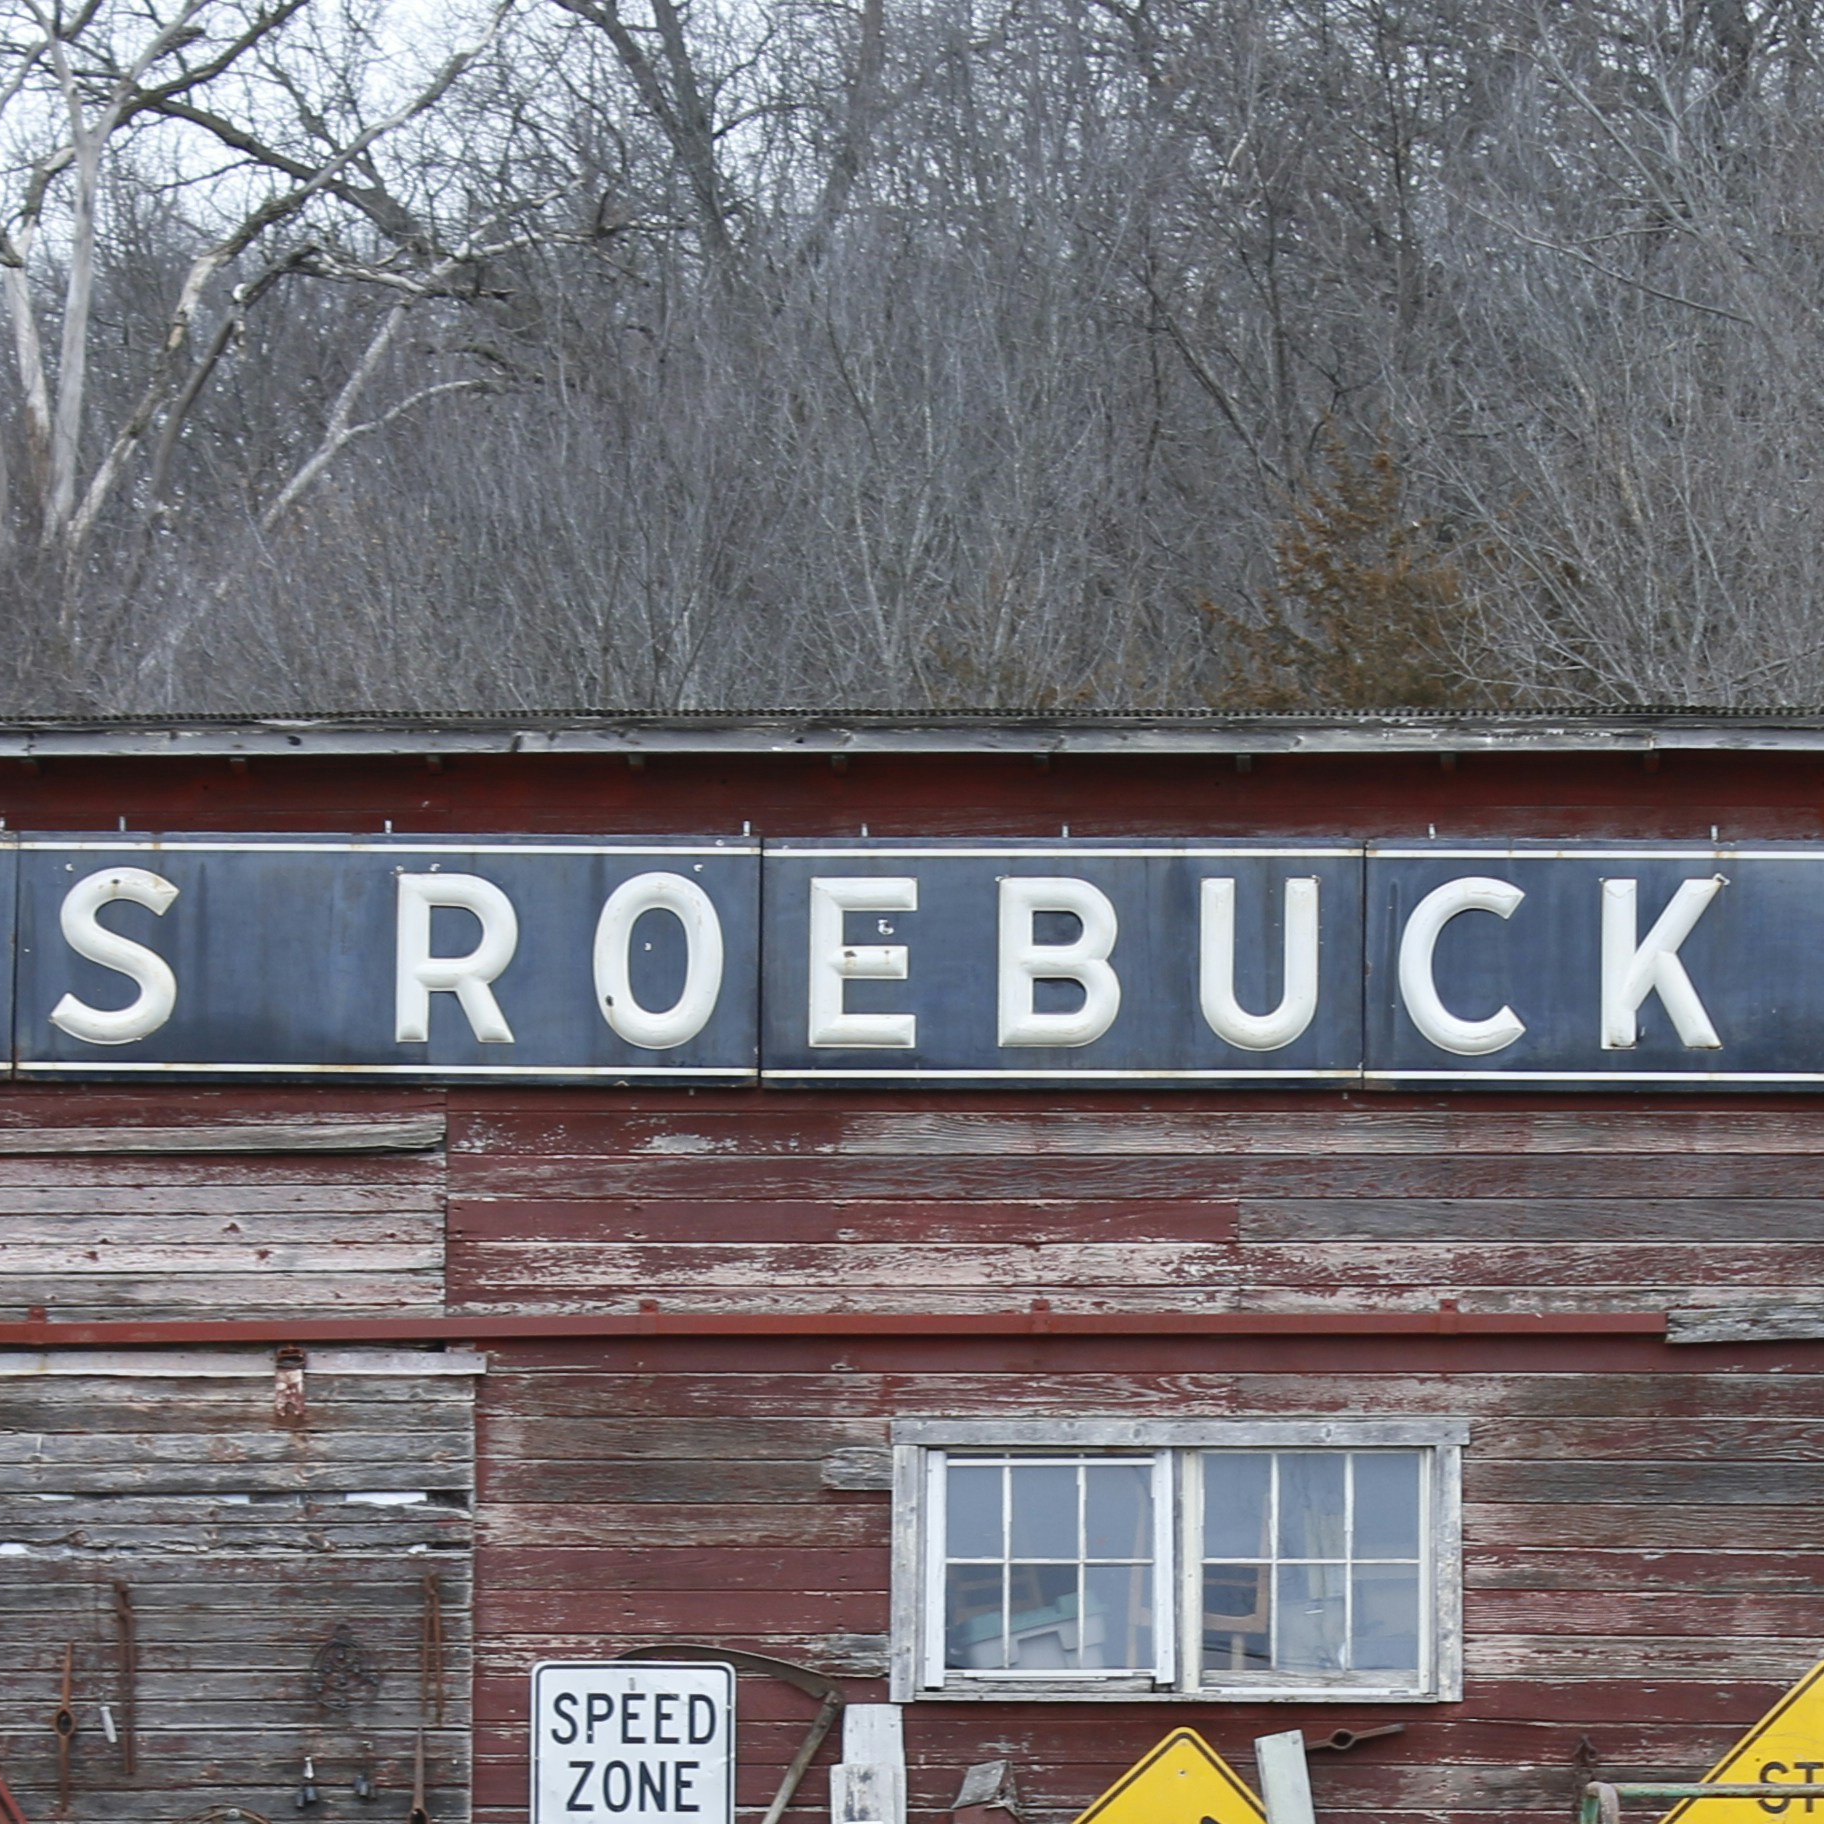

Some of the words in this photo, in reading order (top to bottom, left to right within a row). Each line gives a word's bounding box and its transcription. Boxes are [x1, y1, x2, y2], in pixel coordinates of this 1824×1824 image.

[394, 872, 1732, 1056] ROEBUCK
[550, 1691, 718, 1746] SPEED
[565, 1760, 701, 1813] ZONE
